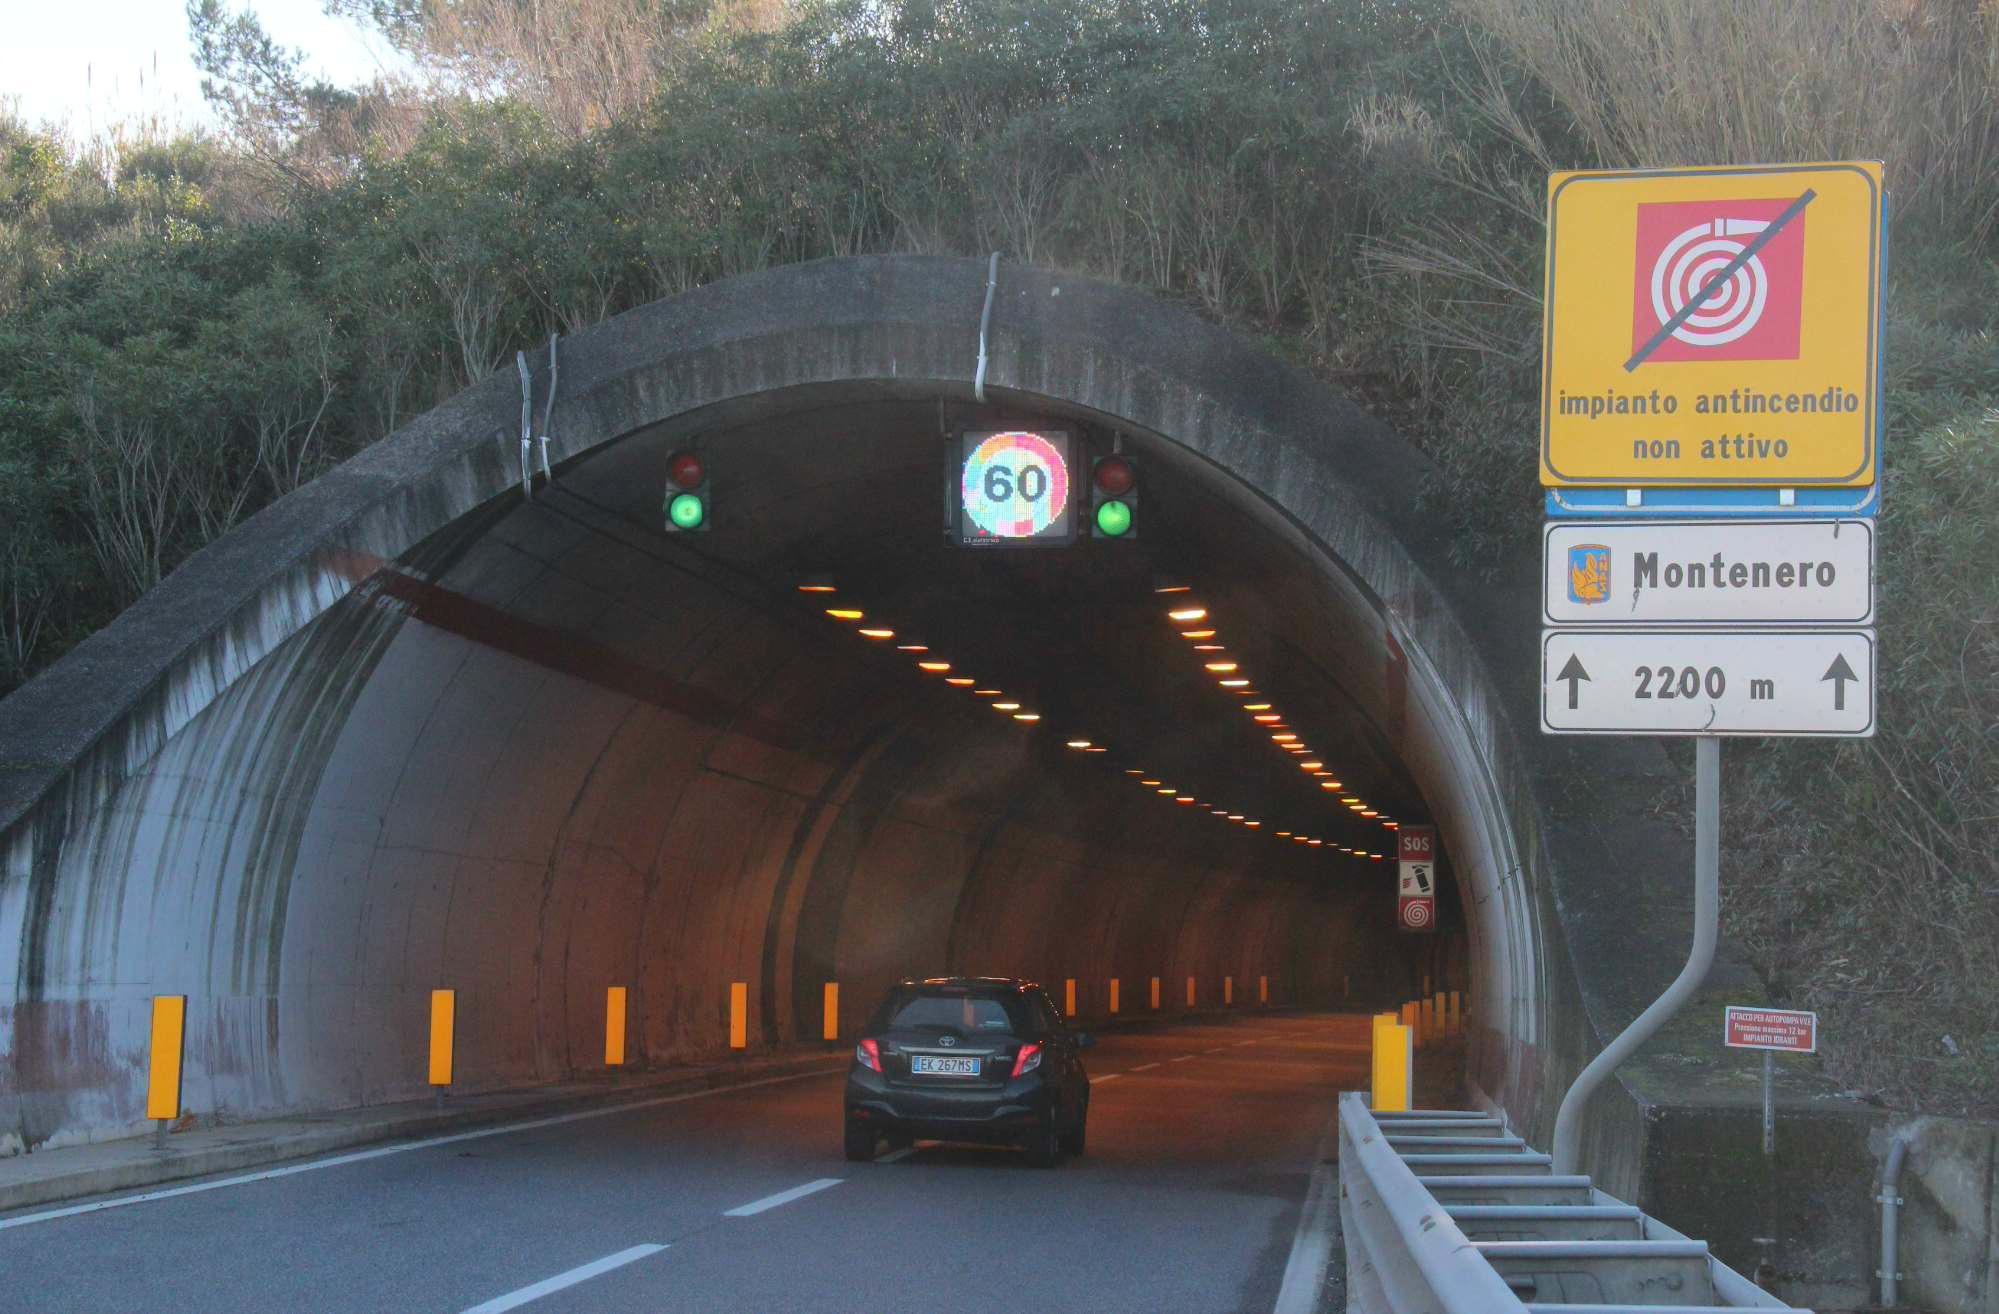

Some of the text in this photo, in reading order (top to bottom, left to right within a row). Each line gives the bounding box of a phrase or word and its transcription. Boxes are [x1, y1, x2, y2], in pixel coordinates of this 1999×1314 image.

[1559, 387, 1859, 420] impianto antincendio
[1633, 433, 1789, 459] non attivo
[984, 464, 1047, 502] 60
[1633, 552, 1836, 588] Montenero
[1634, 666, 1775, 700] 2200 m
[1404, 837, 1430, 852] SOS
[1753, 1013, 1764, 1022] PER
